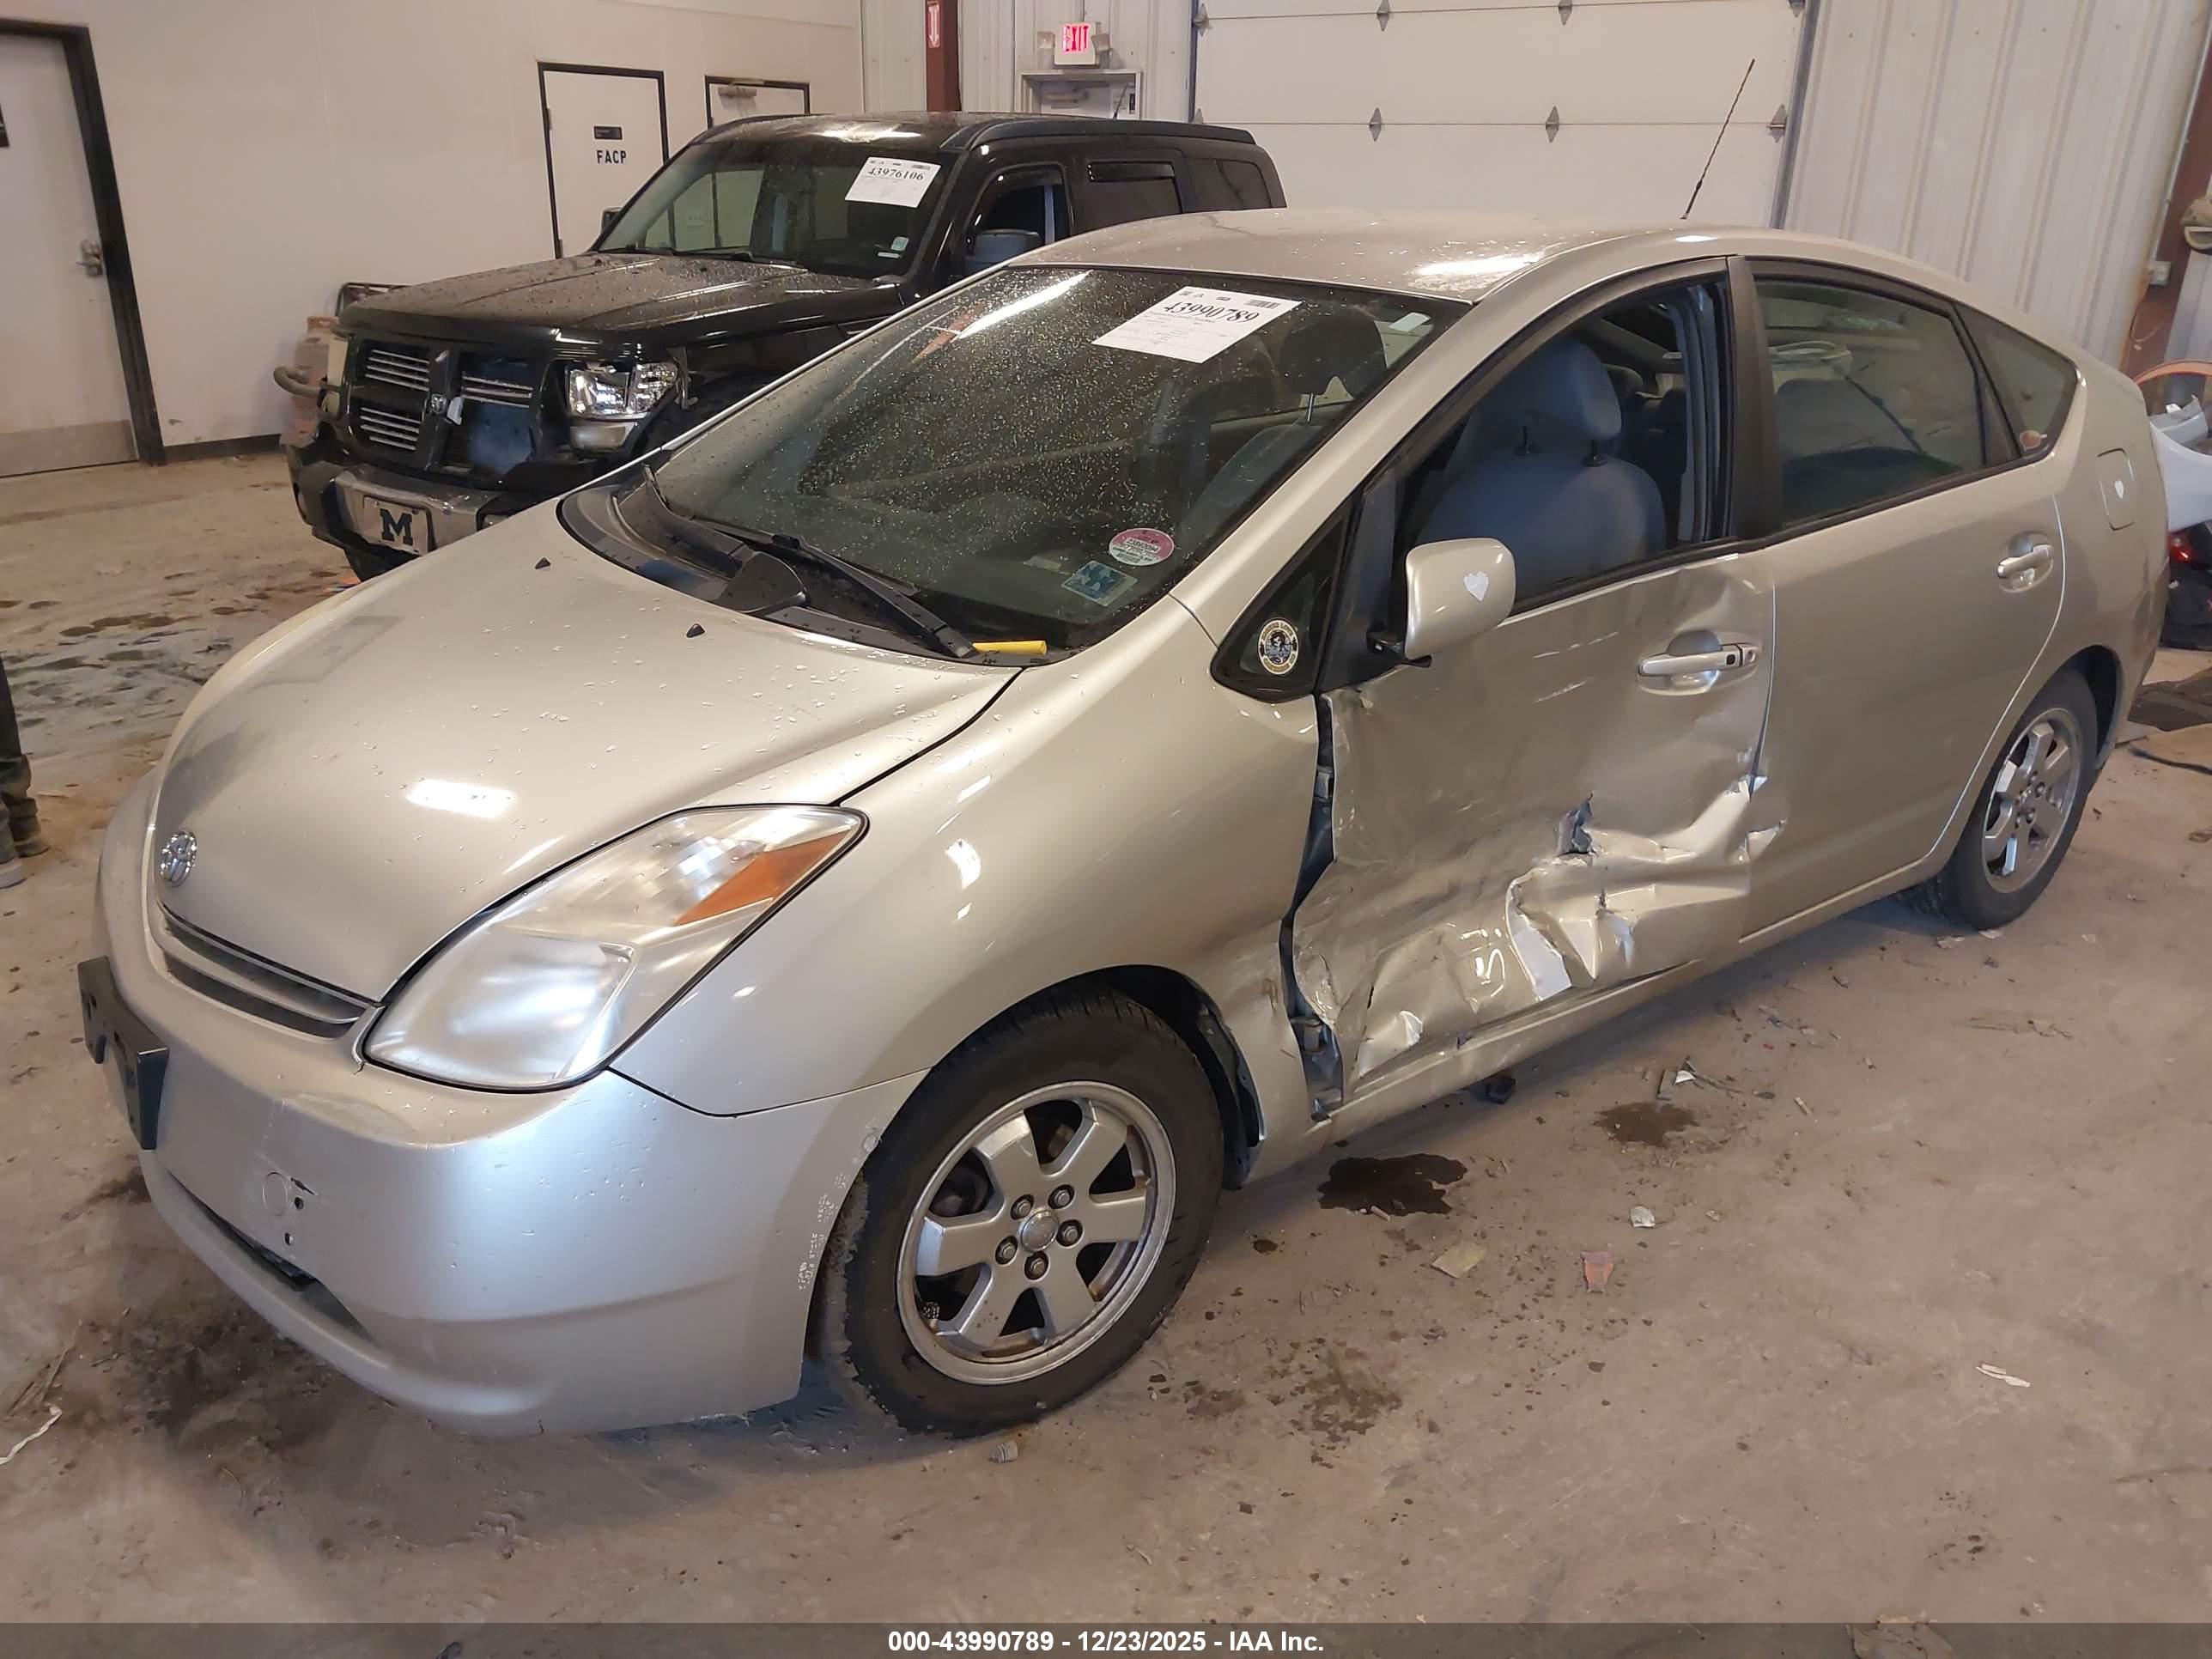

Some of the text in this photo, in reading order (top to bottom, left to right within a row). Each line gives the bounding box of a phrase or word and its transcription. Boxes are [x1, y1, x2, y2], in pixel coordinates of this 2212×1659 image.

[1063, 25, 1089, 52] EXIT
[596, 149, 627, 164] FACP
[867, 167, 924, 181] 43976106
[1164, 301, 1261, 323] 43990789
[379, 507, 414, 546] M
